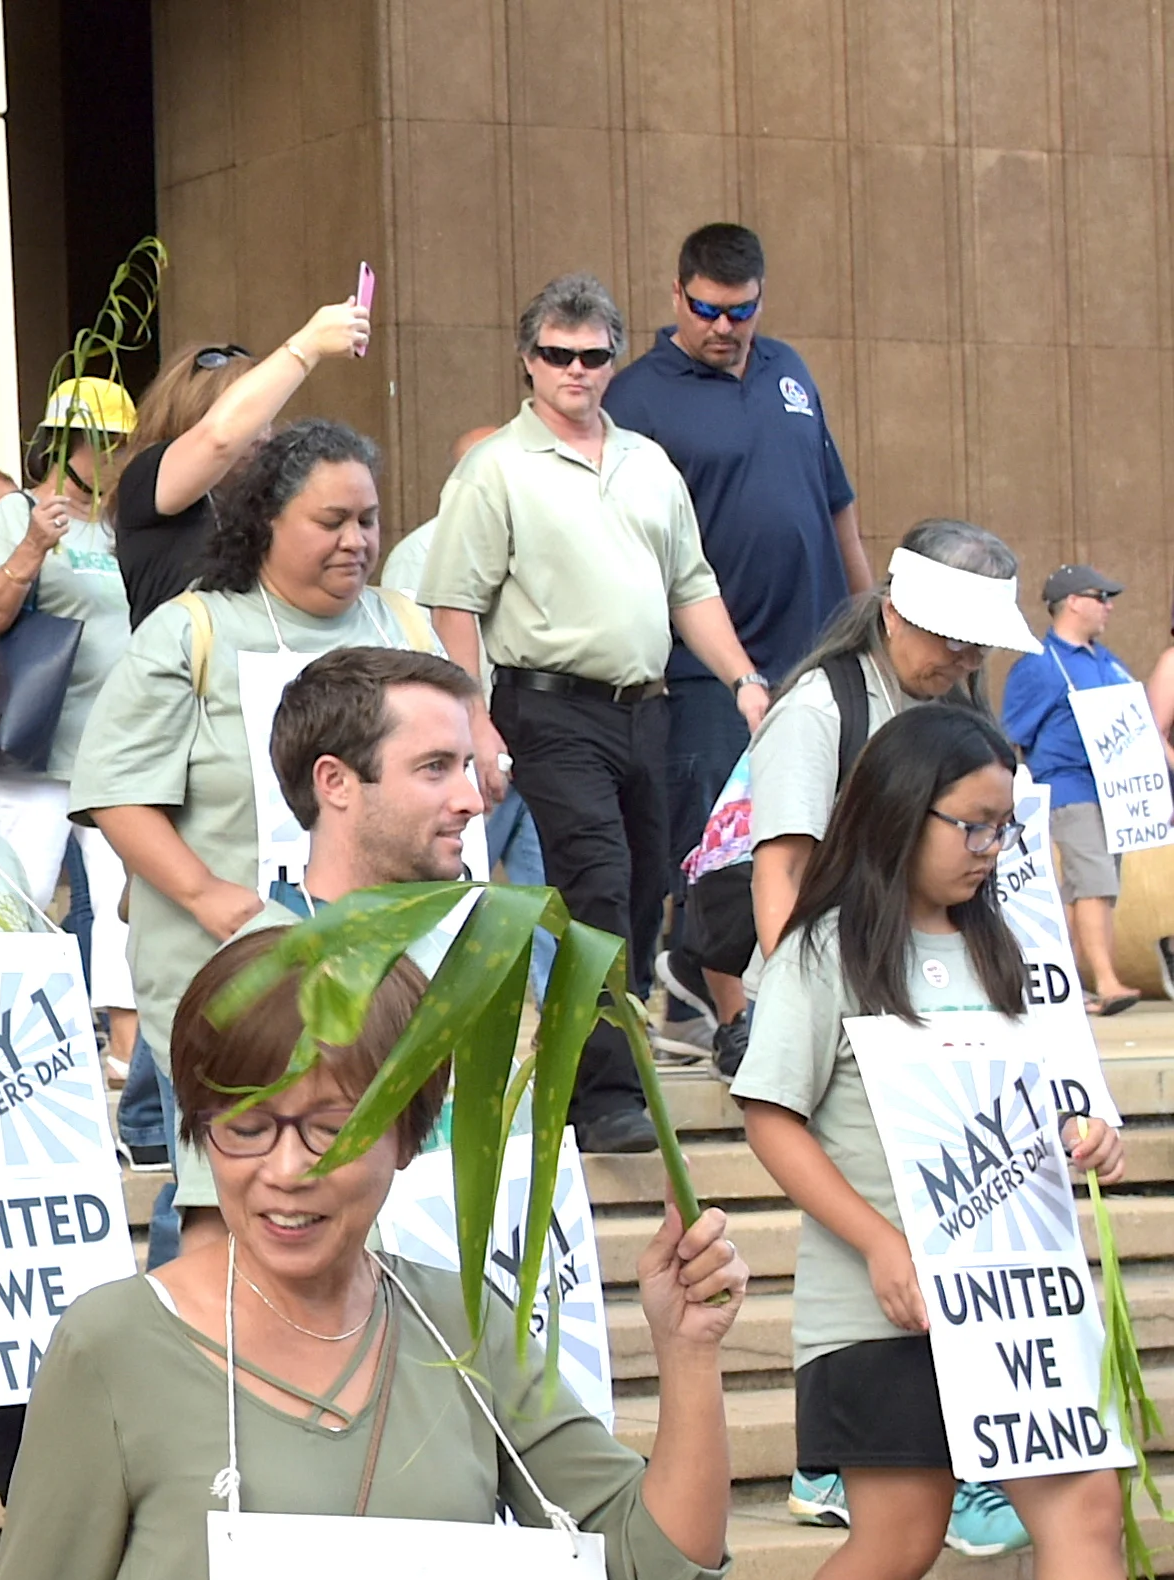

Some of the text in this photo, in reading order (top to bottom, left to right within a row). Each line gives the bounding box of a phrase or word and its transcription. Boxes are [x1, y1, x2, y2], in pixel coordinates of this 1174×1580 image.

[1094, 710, 1131, 758] MAY
[1103, 772, 1165, 799] UNITED
[1126, 799, 1151, 818] WE
[1116, 822, 1168, 848] STAND
[1006, 855, 1037, 893] DAY
[30, 988, 67, 1043] 1
[34, 1042, 76, 1086] DAY
[917, 1097, 1014, 1217] MAY
[1014, 1077, 1040, 1130] 1
[939, 1132, 1050, 1240] WORKERS DAY
[933, 1266, 1086, 1326] UNITED
[995, 1337, 1062, 1390] WE
[973, 1405, 1109, 1469] STAND
